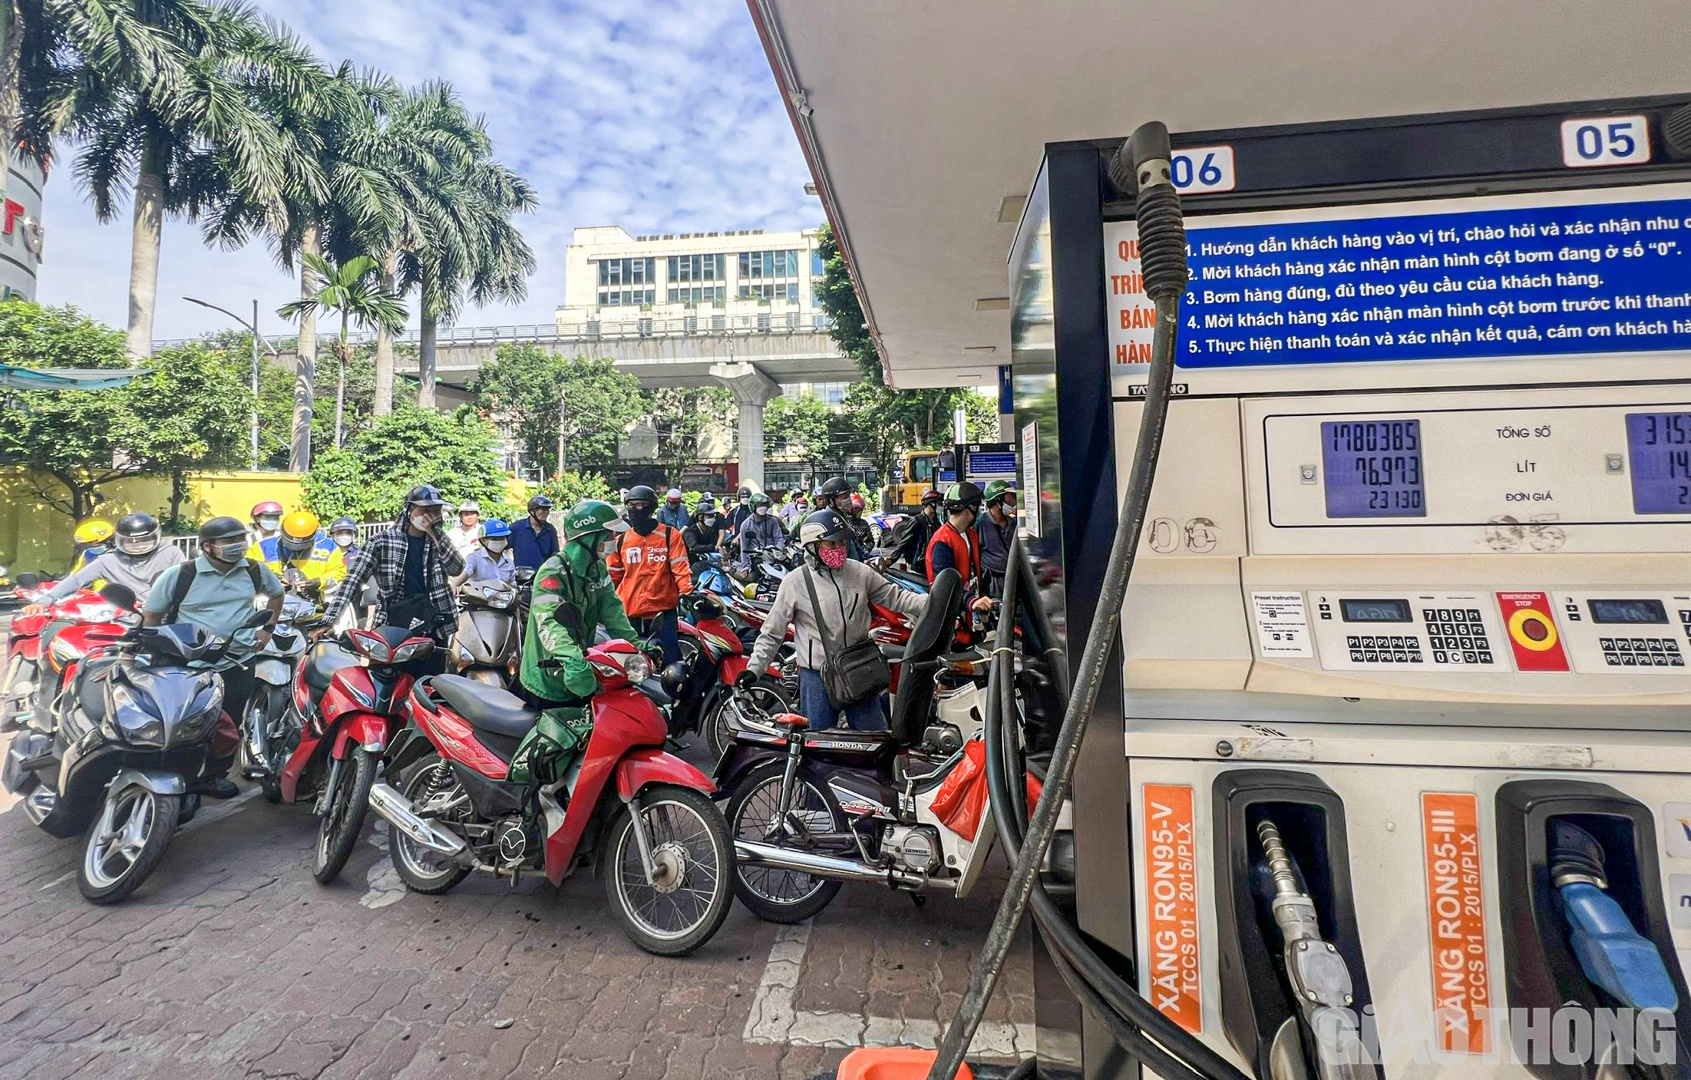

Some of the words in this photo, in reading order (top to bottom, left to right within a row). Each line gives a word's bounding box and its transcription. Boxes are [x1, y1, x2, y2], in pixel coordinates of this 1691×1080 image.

[1576, 123, 1635, 160] 05
[1171, 153, 1222, 188] 06
[1201, 241, 1254, 257] Hướng
[1259, 237, 1286, 252] dẫn
[1291, 234, 1338, 250] khách
[1342, 231, 1381, 248] hàng
[1386, 231, 1415, 245] vào
[1419, 229, 1434, 246] vị
[1438, 229, 1460, 243] trí,
[1464, 226, 1505, 241] chào
[1510, 223, 1535, 238] hỏi
[1540, 222, 1559, 236] và
[1564, 219, 1593, 235] xác
[1599, 217, 1641, 234] nhận
[1646, 217, 1679, 231] nhu
[1118, 240, 1142, 261] QU
[1203, 265, 1231, 280] Mời
[1235, 262, 1281, 278] khách
[1286, 261, 1324, 277] hàng
[1329, 259, 1356, 273] xác
[1361, 257, 1400, 273] nhận
[1405, 255, 1439, 269] màn
[1444, 252, 1479, 268] hình
[1484, 250, 1510, 267] cột
[1515, 248, 1554, 263] bơm
[1558, 246, 1600, 263] đang
[1605, 244, 1619, 258] ở
[1622, 240, 1644, 257] số
[1111, 272, 1146, 295] TRÌ
[1186, 293, 1199, 305] 3.
[1204, 290, 1240, 305] Bơm
[1244, 288, 1282, 304] hàng
[1286, 286, 1331, 301] đúng,
[1335, 283, 1355, 298] đủ
[1360, 282, 1395, 296] theo
[1400, 281, 1428, 297] yêu
[1433, 276, 1462, 292] cầu
[1467, 276, 1496, 290] của
[1501, 273, 1552, 289] khách
[1556, 272, 1604, 288] hàng.
[1120, 305, 1156, 329] BÁN
[1187, 317, 1200, 329] 4.
[1205, 314, 1234, 328] Mời
[1237, 311, 1284, 327] khách
[1288, 311, 1327, 326] hàng
[1331, 309, 1359, 323] xác
[1363, 306, 1403, 323] nhận
[1407, 304, 1442, 319] màn
[1447, 302, 1482, 317] hình
[1488, 300, 1514, 317] cột
[1518, 298, 1558, 314] bơm
[1562, 296, 1611, 312] trước
[1615, 295, 1641, 310] khi
[1188, 340, 1202, 353] 5.
[1206, 338, 1245, 354] Thực
[1249, 336, 1283, 353] hiện
[1286, 333, 1331, 349] thanh
[1335, 332, 1370, 347] toán
[1374, 332, 1394, 346] và
[1398, 330, 1426, 345] xác
[1431, 328, 1472, 345] nhận
[1476, 324, 1502, 341] kết
[1507, 324, 1542, 342] quả,
[1546, 323, 1582, 339] cám
[1587, 323, 1611, 337] ơn
[1615, 320, 1668, 336] khách
[1116, 340, 1152, 364] HÀN
[1333, 423, 1418, 451] 1780385
[1496, 425, 1530, 439] TỔNG
[1646, 416, 1691, 445] 315
[1517, 459, 1537, 473] LÍT
[1369, 490, 1421, 509] 23130
[1506, 492, 1530, 502] ĐƠN
[1533, 490, 1553, 501] GIÁ
[573, 516, 597, 529] Grab
[647, 546, 668, 554] Shope
[647, 554, 667, 563] Foo
[1425, 611, 1433, 620] 7
[1440, 611, 1448, 620] 8
[1455, 611, 1463, 620] 9
[1469, 612, 1478, 620] F1
[1430, 625, 1438, 634] 4
[1444, 625, 1452, 634] 5
[1459, 625, 1467, 634] 6
[1349, 639, 1359, 647] P1
[1364, 639, 1374, 647] P2
[1378, 639, 1389, 647] P3
[1392, 639, 1403, 647] P4
[1407, 639, 1418, 647] P5
[1434, 639, 1440, 647] 1
[1448, 639, 1456, 648] 2
[1463, 639, 1471, 648] 3
[1618, 641, 1630, 649] P2
[1634, 641, 1645, 649] P3
[1649, 641, 1661, 649] P4
[1665, 641, 1677, 649] P5
[1352, 652, 1363, 660] P6
[1366, 652, 1377, 660] P7
[1381, 652, 1391, 660] P8
[1395, 652, 1406, 660] P9
[1409, 652, 1422, 660] P10
[1436, 653, 1444, 662] 0
[1451, 653, 1460, 661] C
[1669, 656, 1685, 664] P10
[831, 742, 865, 750] HONDA
[1151, 801, 1178, 921] RON95-V
[1176, 821, 1194, 903] 2015/PLX
[1431, 809, 1463, 940] RON95-III
[1459, 832, 1481, 917] 2015/PLX
[1180, 920, 1196, 938] 01
[1468, 939, 1483, 955] 01
[1152, 931, 1181, 1012] XĂNG
[1181, 944, 1198, 994] TCCS
[1437, 949, 1469, 1036] XĂNG
[1468, 962, 1487, 1012] TCCS
